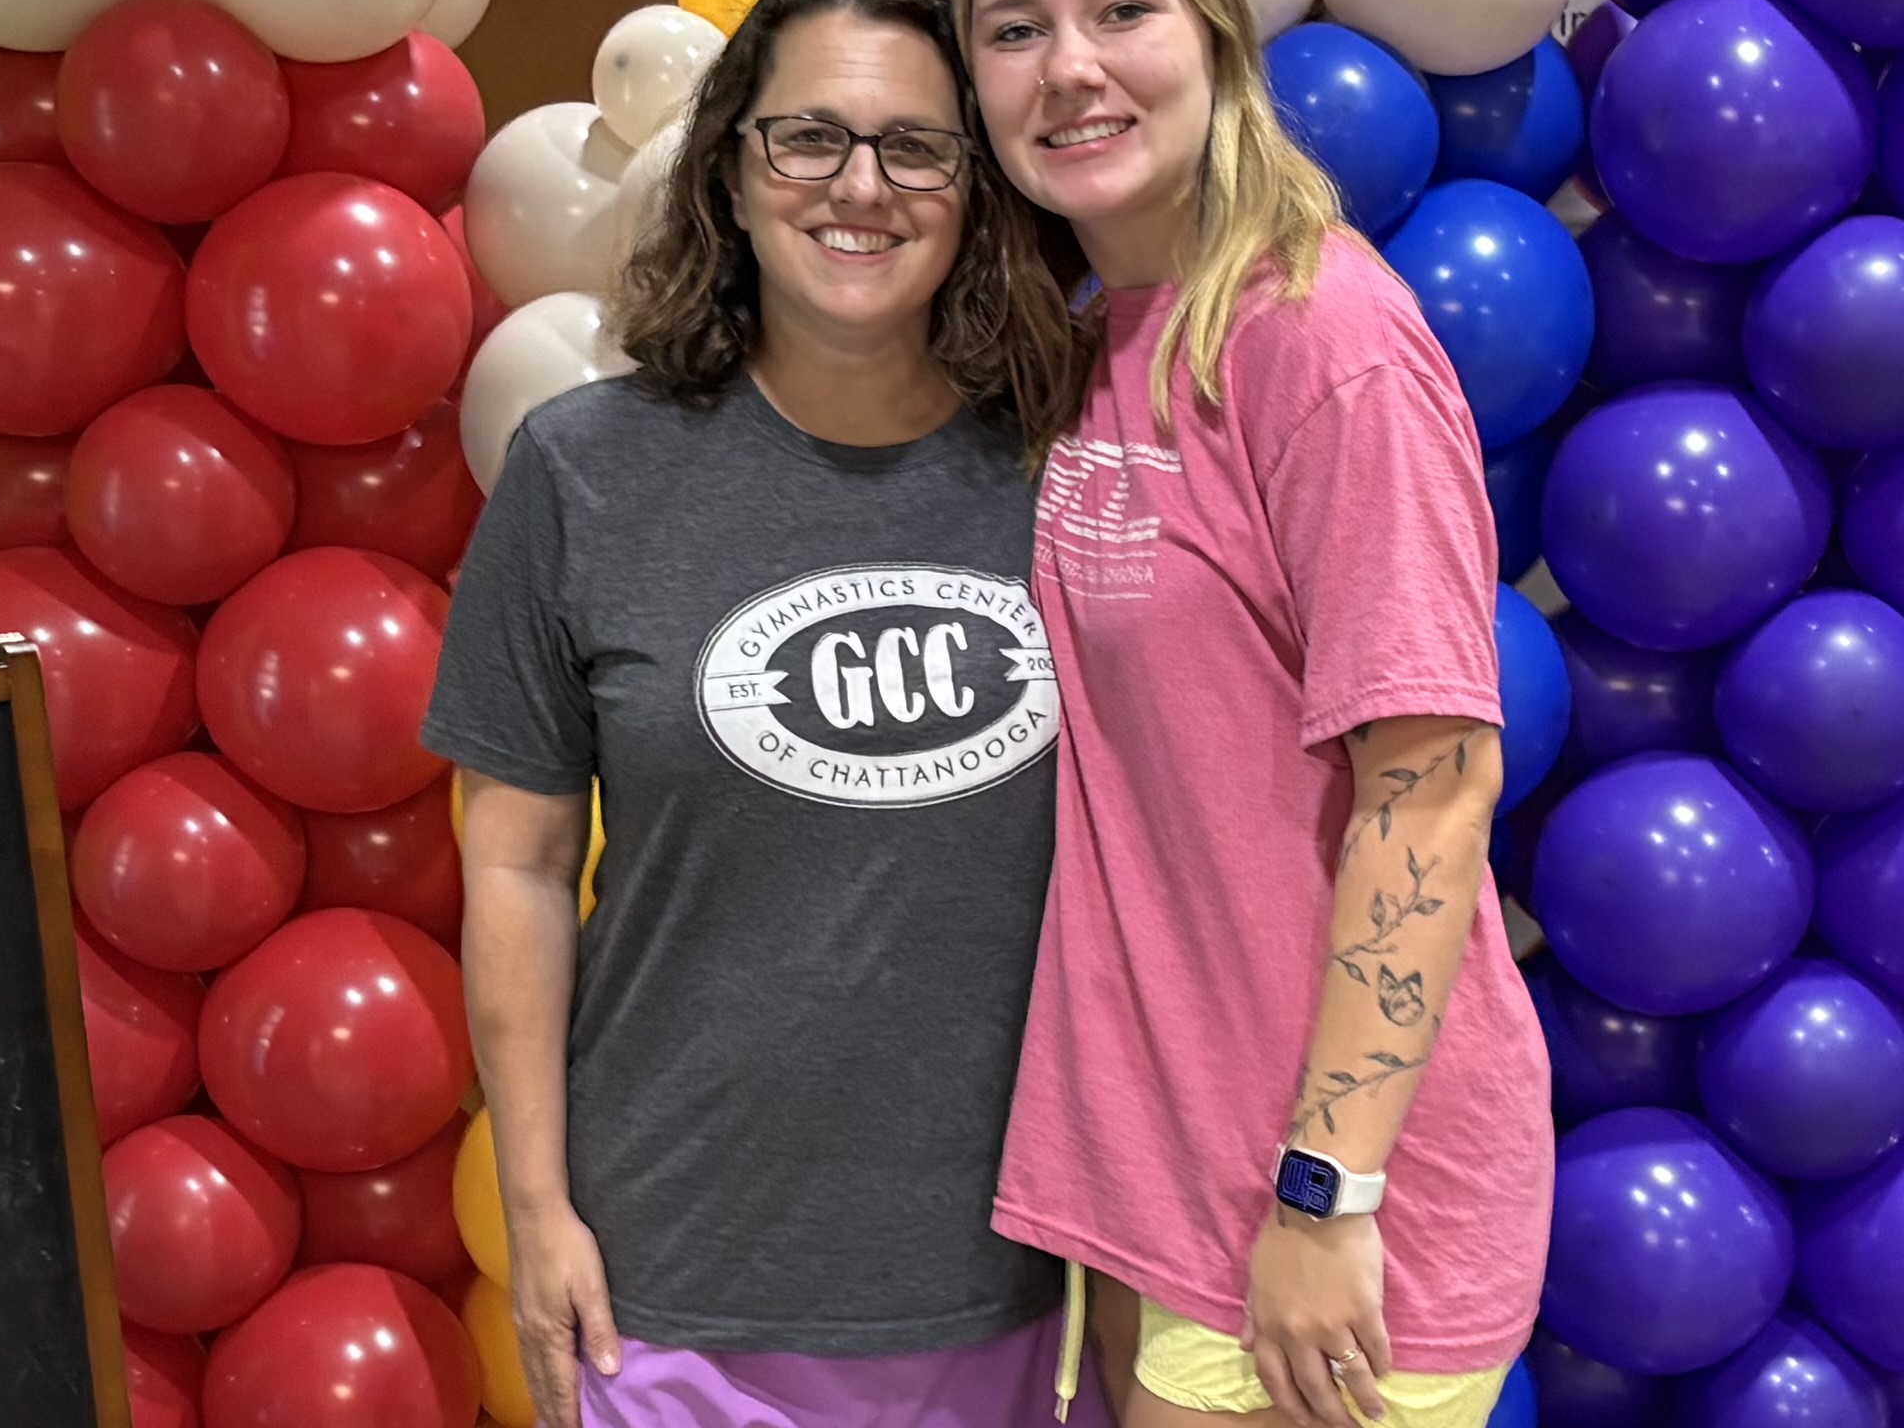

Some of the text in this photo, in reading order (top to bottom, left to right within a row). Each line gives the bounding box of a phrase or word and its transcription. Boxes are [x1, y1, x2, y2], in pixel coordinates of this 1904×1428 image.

[739, 578, 1039, 659] GYMNASTICS CENTER
[728, 681, 764, 700] EST.
[810, 621, 976, 731] GCC
[757, 707, 1049, 790] OF CHATTANOOGA
